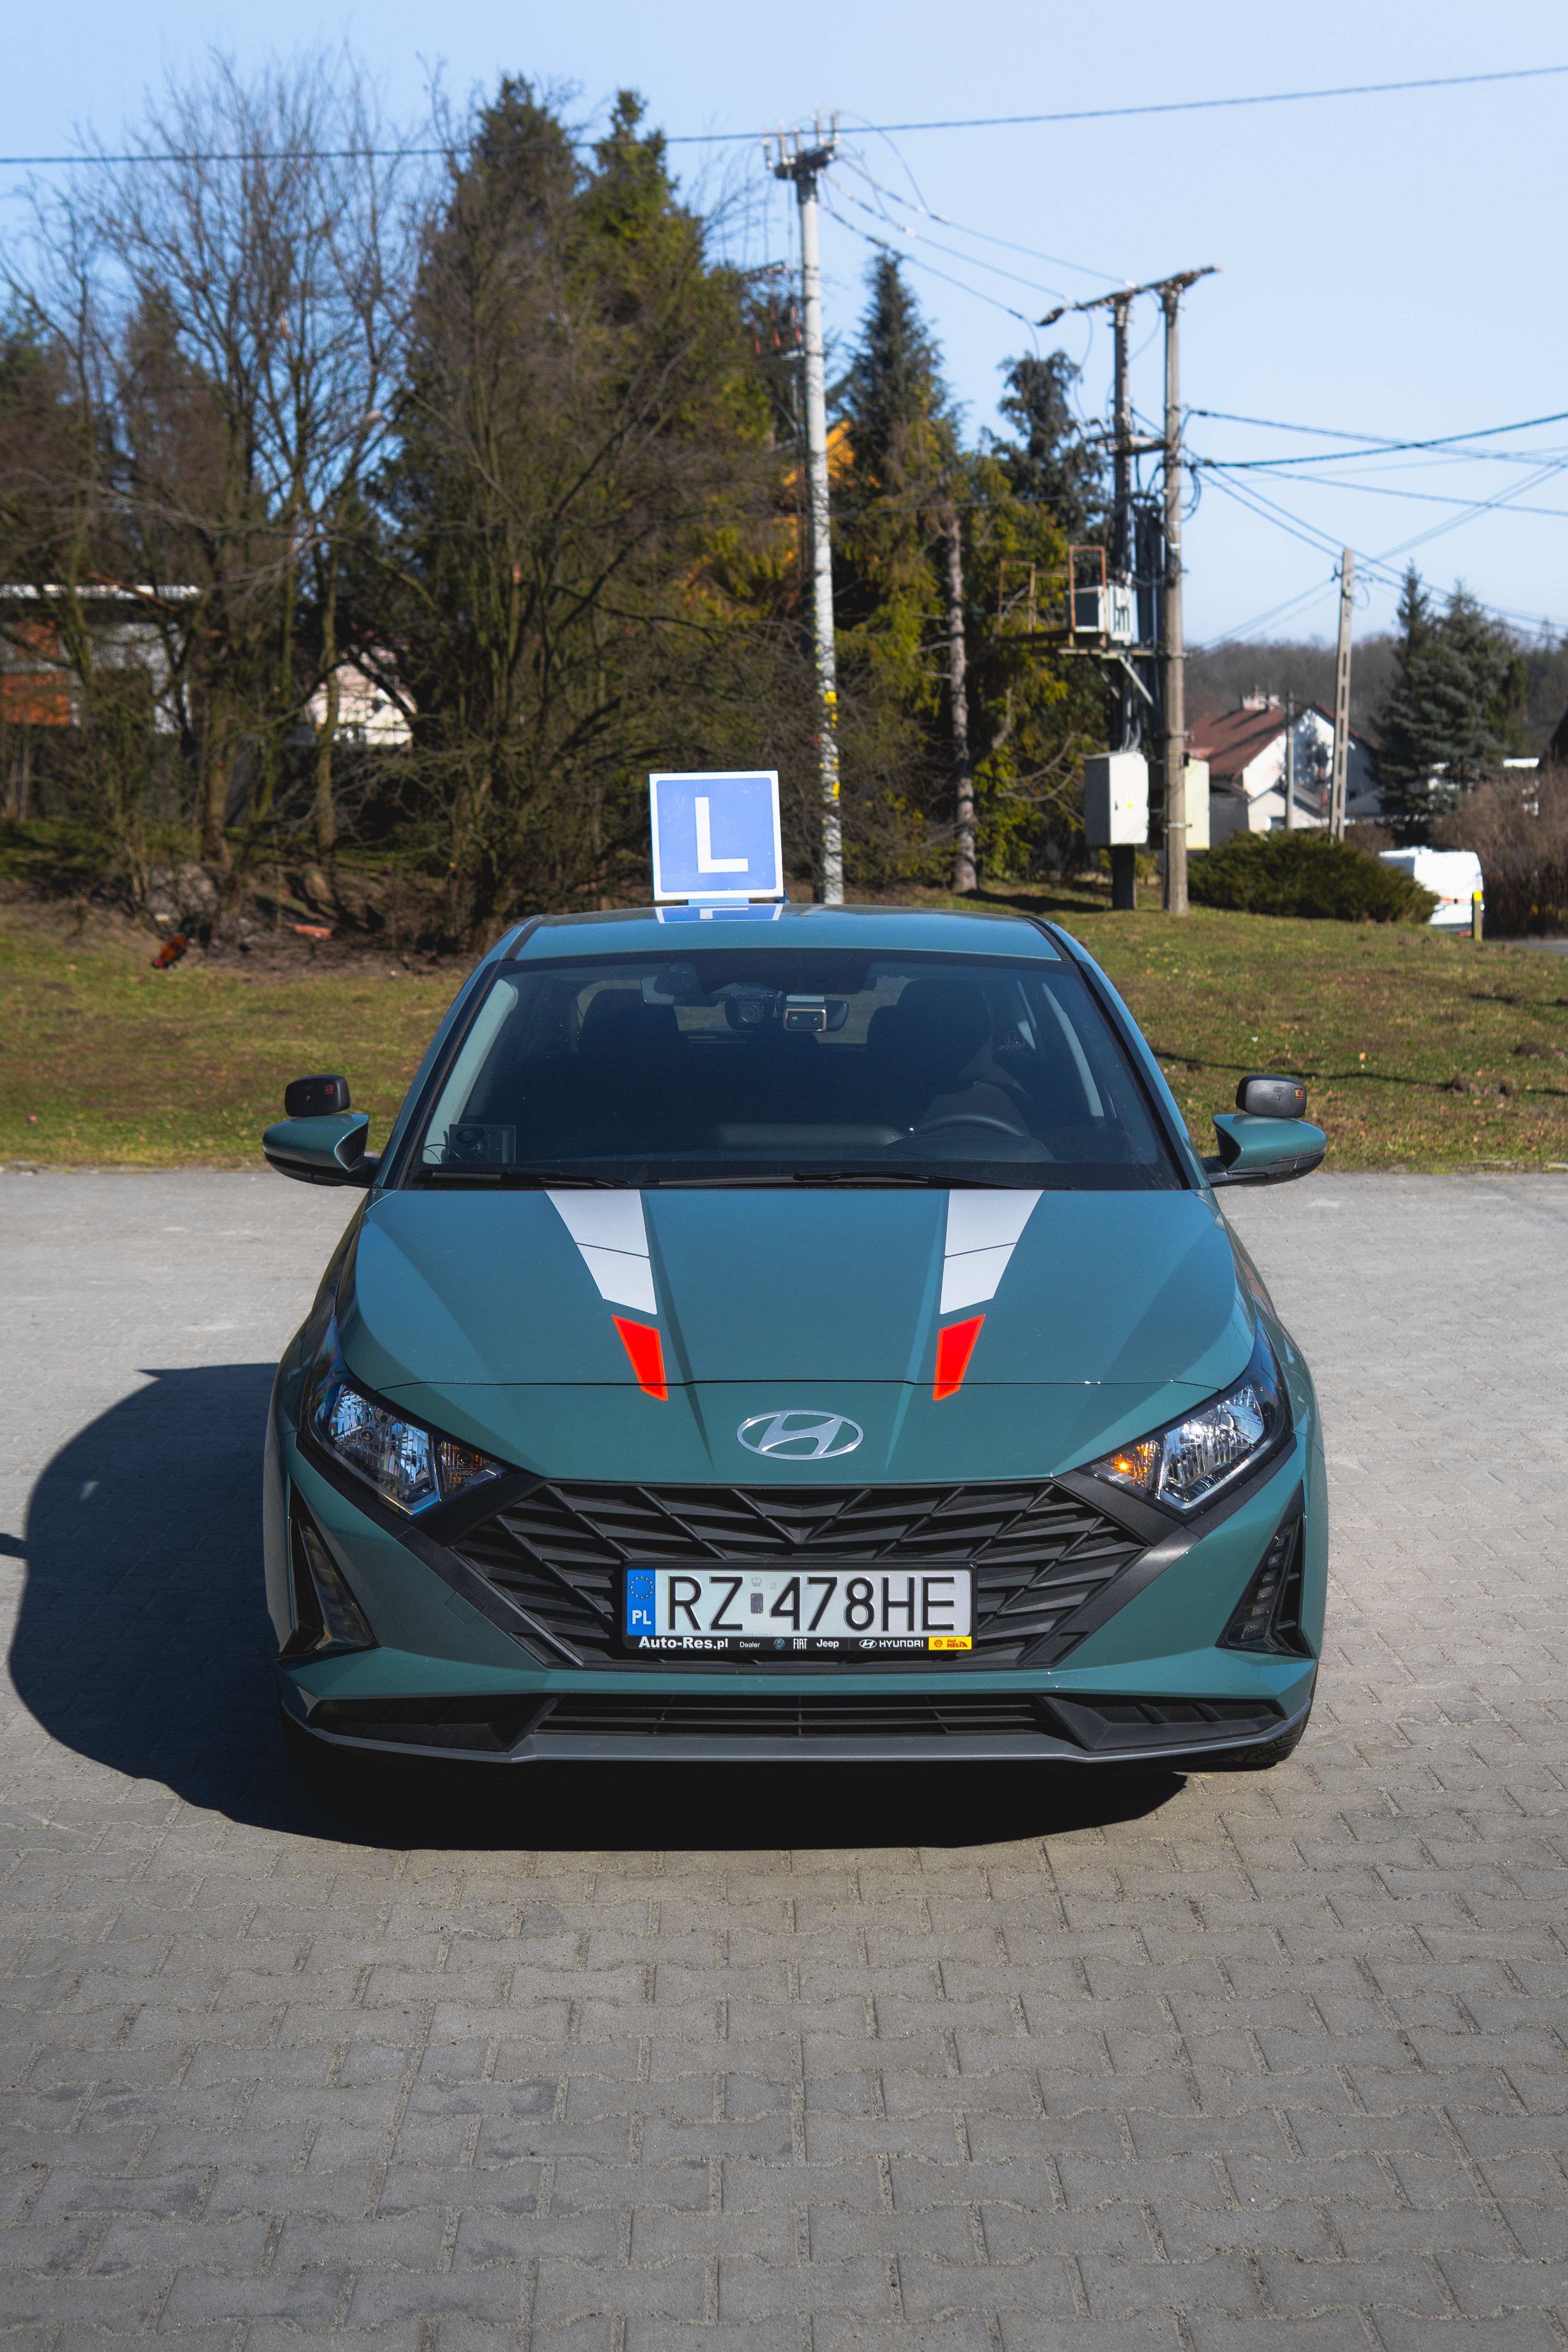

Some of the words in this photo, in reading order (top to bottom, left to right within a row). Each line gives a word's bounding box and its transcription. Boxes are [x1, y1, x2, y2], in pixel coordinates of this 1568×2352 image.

[695, 797, 748, 873] L
[632, 1610, 651, 1625] PL
[668, 1576, 743, 1630] RZ
[770, 1576, 955, 1631] 478HE
[639, 1636, 728, 1649] Auto-Res.pl
[793, 1638, 808, 1649] FIAT
[816, 1639, 839, 1649] Jeep
[879, 1640, 924, 1648] HYUNDAI
